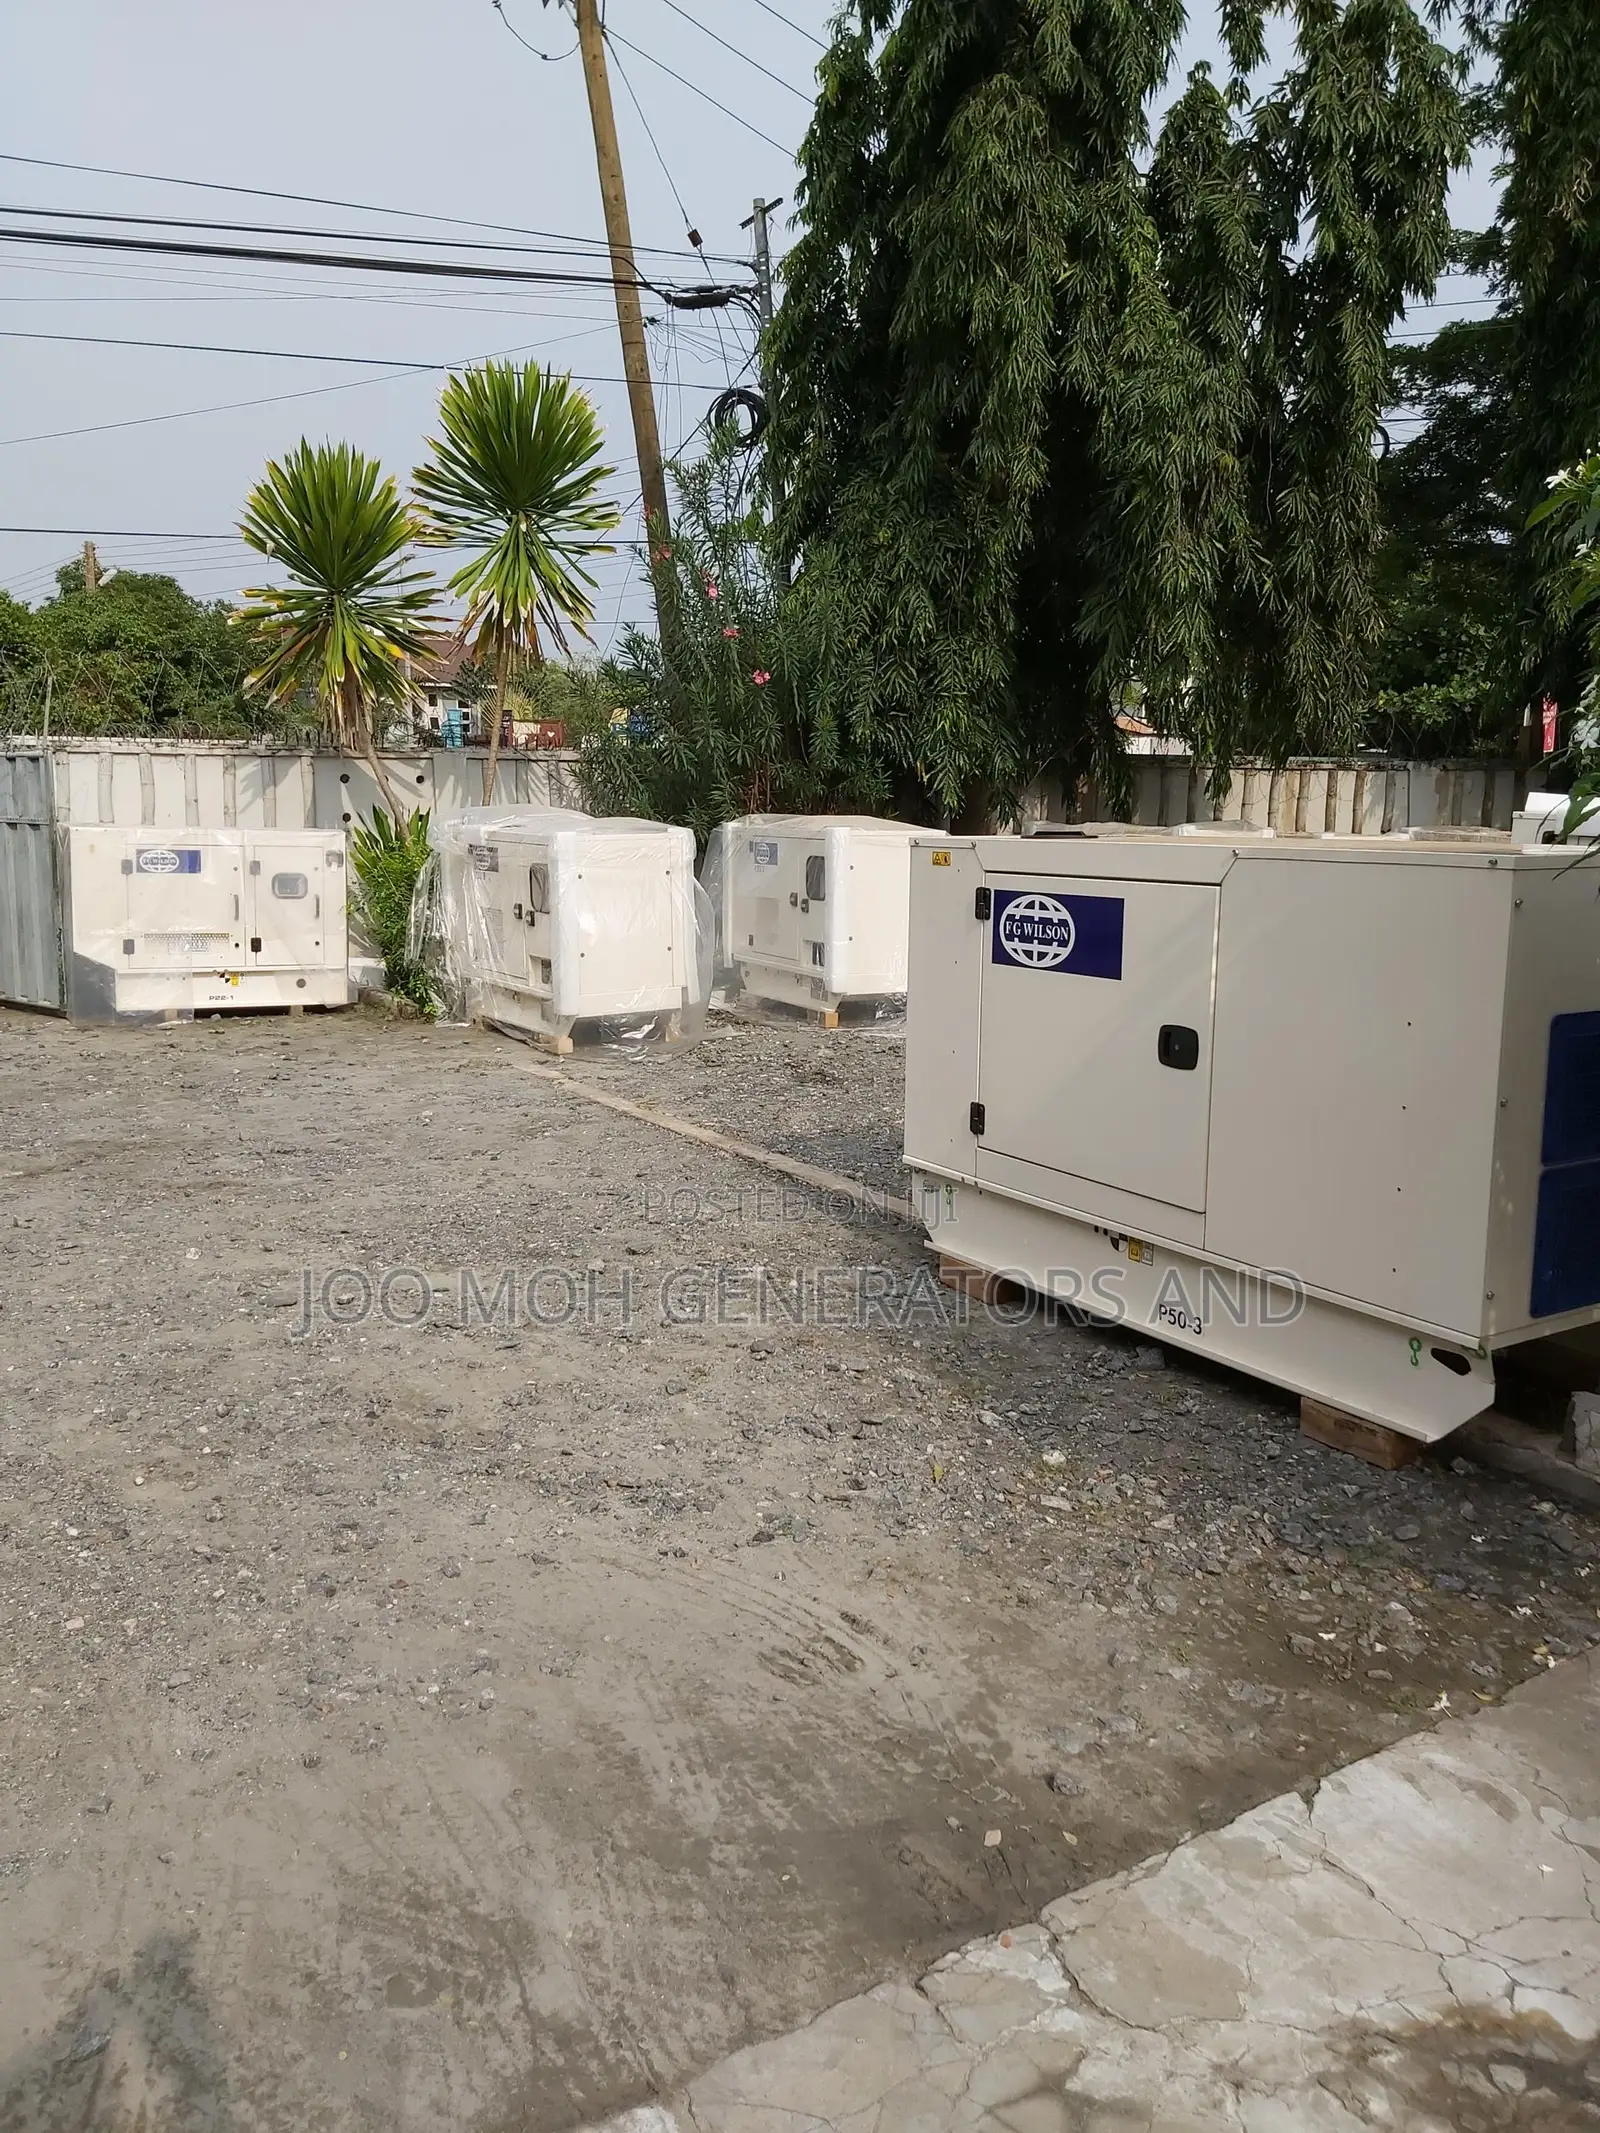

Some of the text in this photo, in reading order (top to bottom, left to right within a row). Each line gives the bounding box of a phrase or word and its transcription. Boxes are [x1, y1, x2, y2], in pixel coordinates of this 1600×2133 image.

[1005, 920, 1069, 941] FG WILSON
[1157, 1303, 1203, 1336] P50-3
